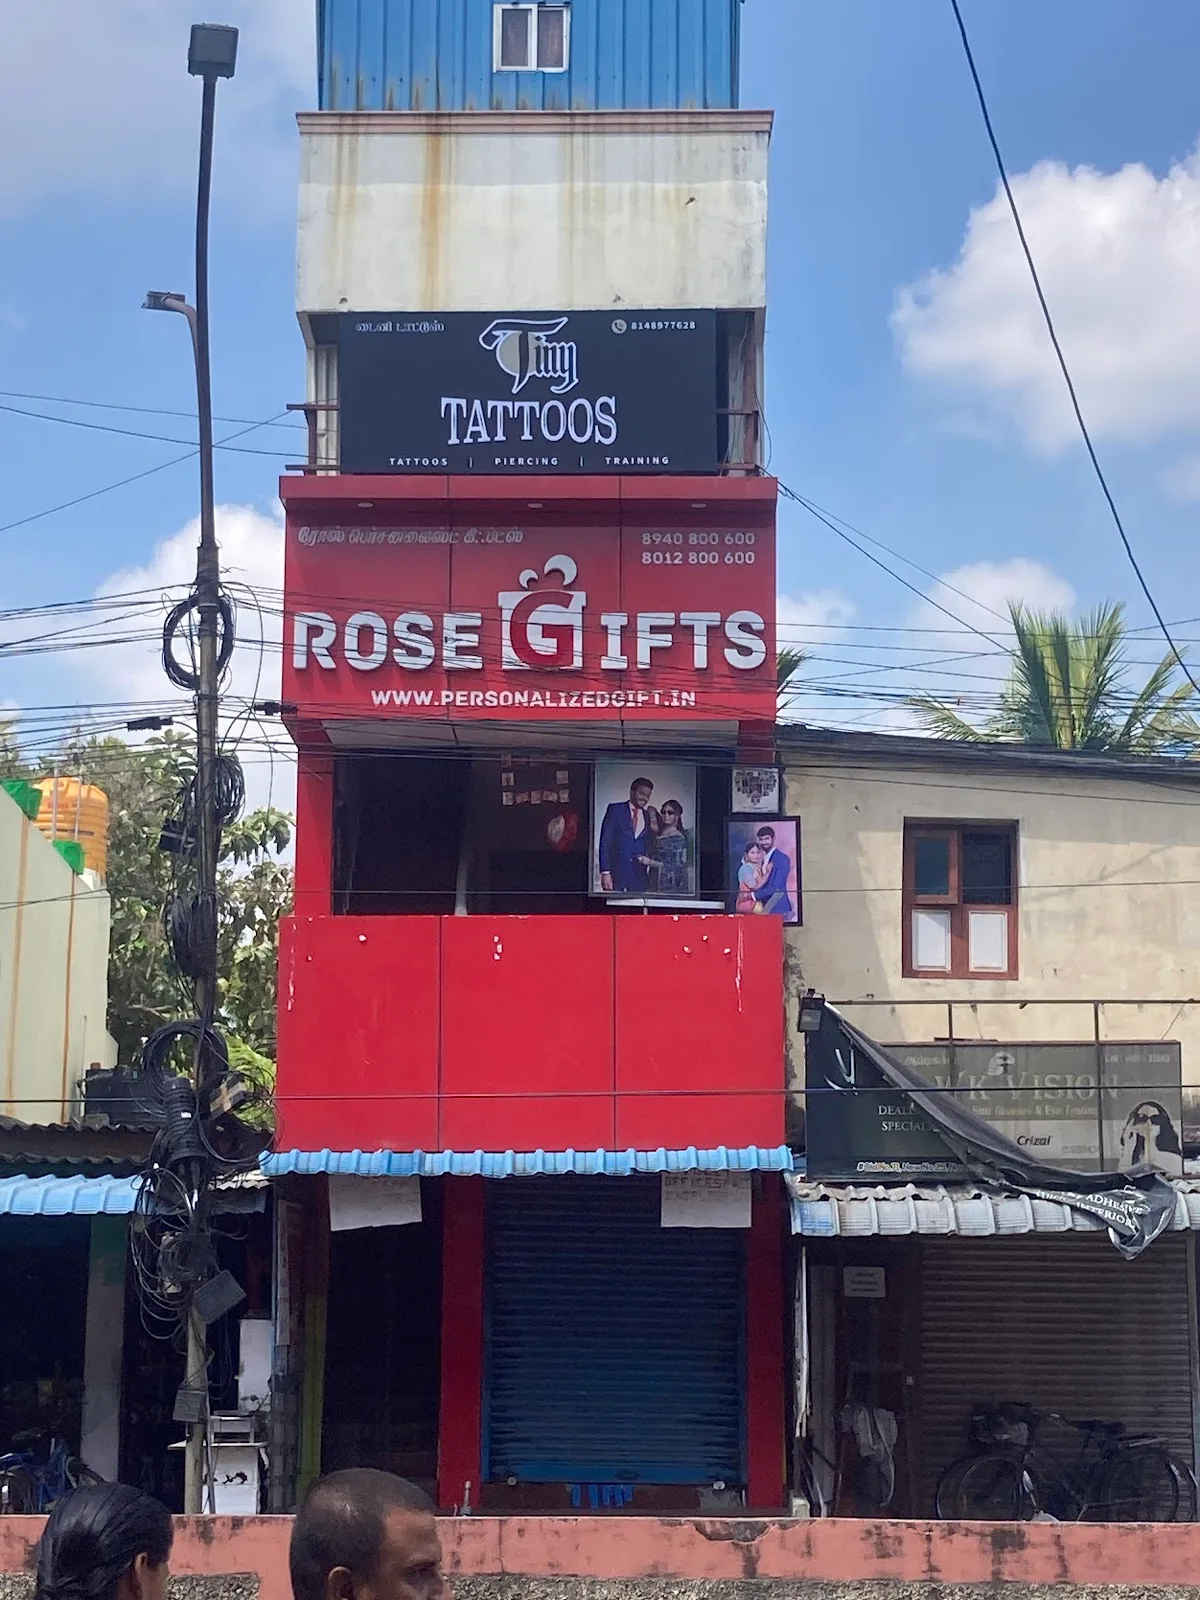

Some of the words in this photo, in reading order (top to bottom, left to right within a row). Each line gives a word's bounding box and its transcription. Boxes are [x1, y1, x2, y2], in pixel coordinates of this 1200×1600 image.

[631, 320, 696, 330] 8148977628
[479, 316, 579, 394] Tiny
[440, 396, 618, 445] TATTOOS
[389, 457, 448, 466] TATTOOS
[494, 457, 558, 466] PIERCING
[604, 456, 670, 466] TRAINING
[641, 532, 683, 546] 8940
[688, 532, 719, 546] 800
[724, 532, 755, 546] 600
[641, 551, 683, 565] 8012
[688, 551, 719, 565] 800
[724, 551, 755, 565] 600
[293, 610, 483, 671] ROSE
[371, 689, 697, 709] WWW.PERSONALIZEDGIFT.IN
[1017, 1135, 1052, 1147] Crizal
